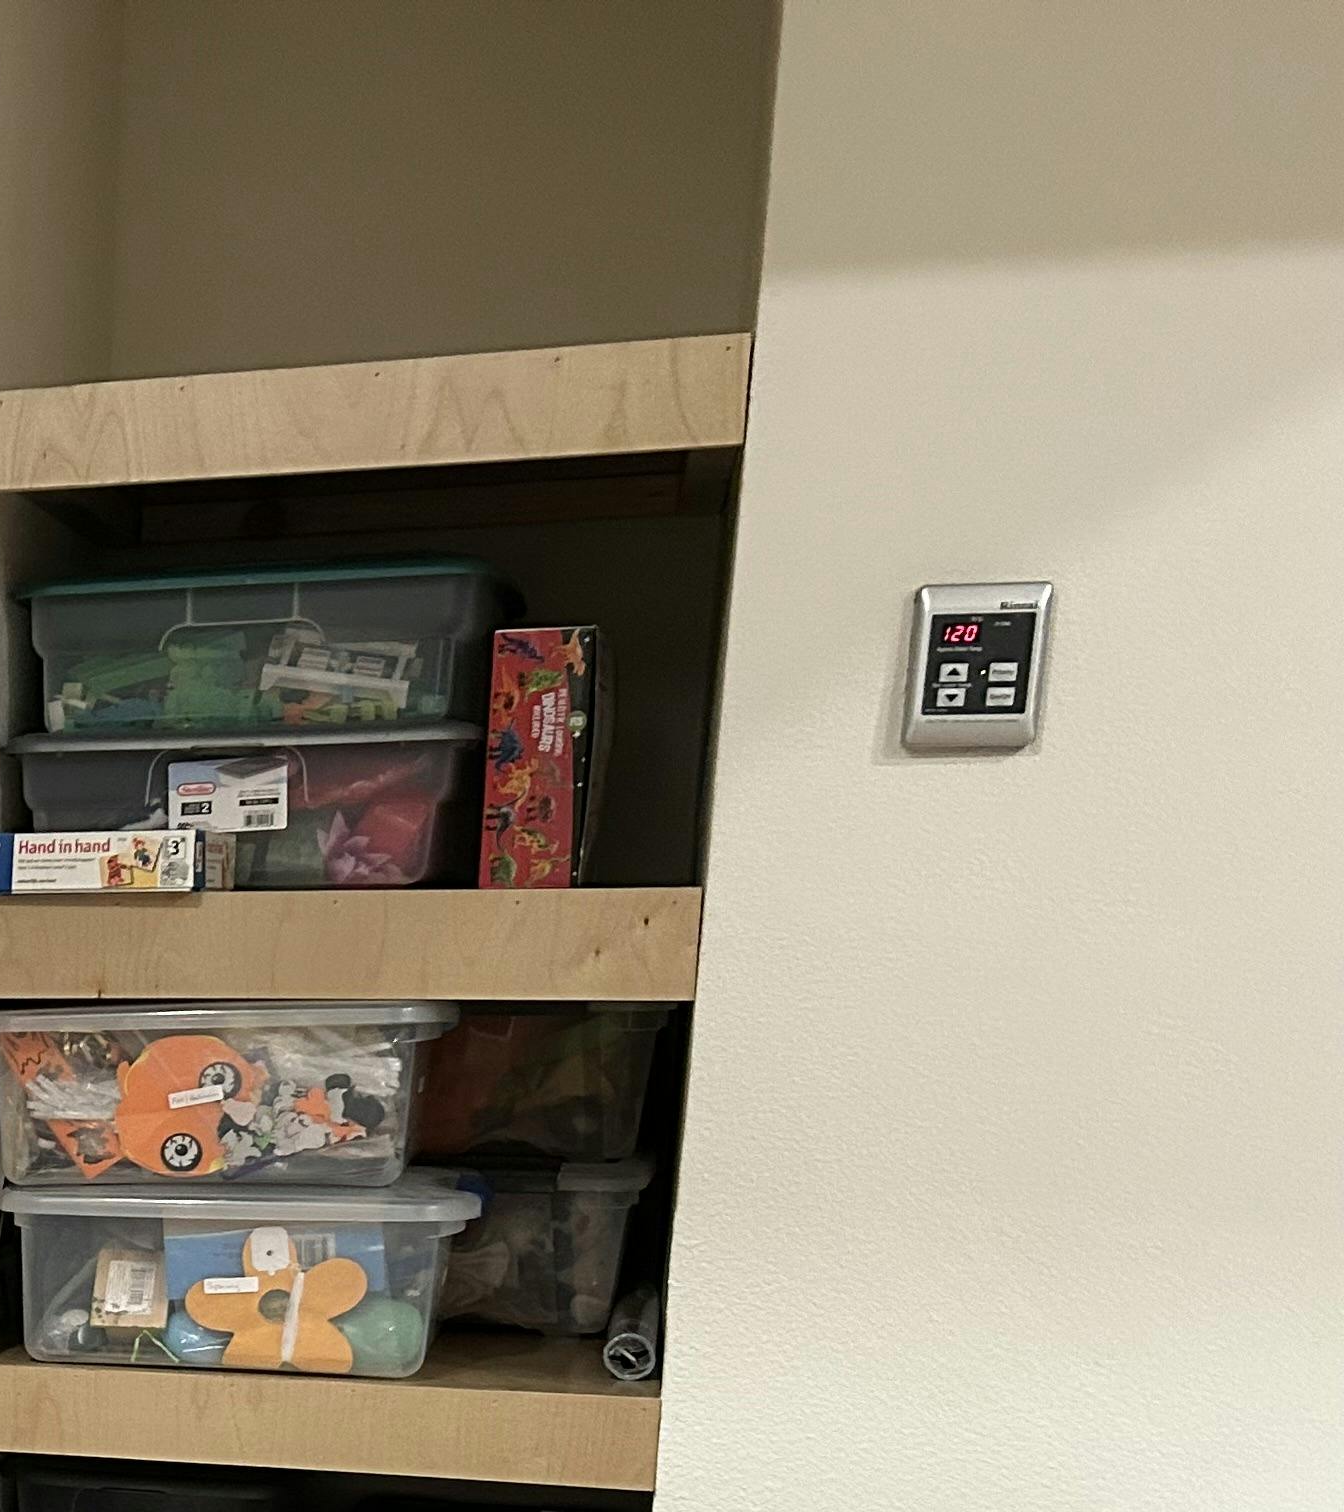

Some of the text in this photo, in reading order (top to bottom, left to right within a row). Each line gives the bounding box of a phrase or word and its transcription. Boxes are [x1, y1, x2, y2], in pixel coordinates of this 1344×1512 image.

[944, 625, 978, 641] 120
[538, 692, 556, 752] DINOSAURS
[201, 803, 210, 813] 2
[18, 837, 111, 854] Hand in hand
